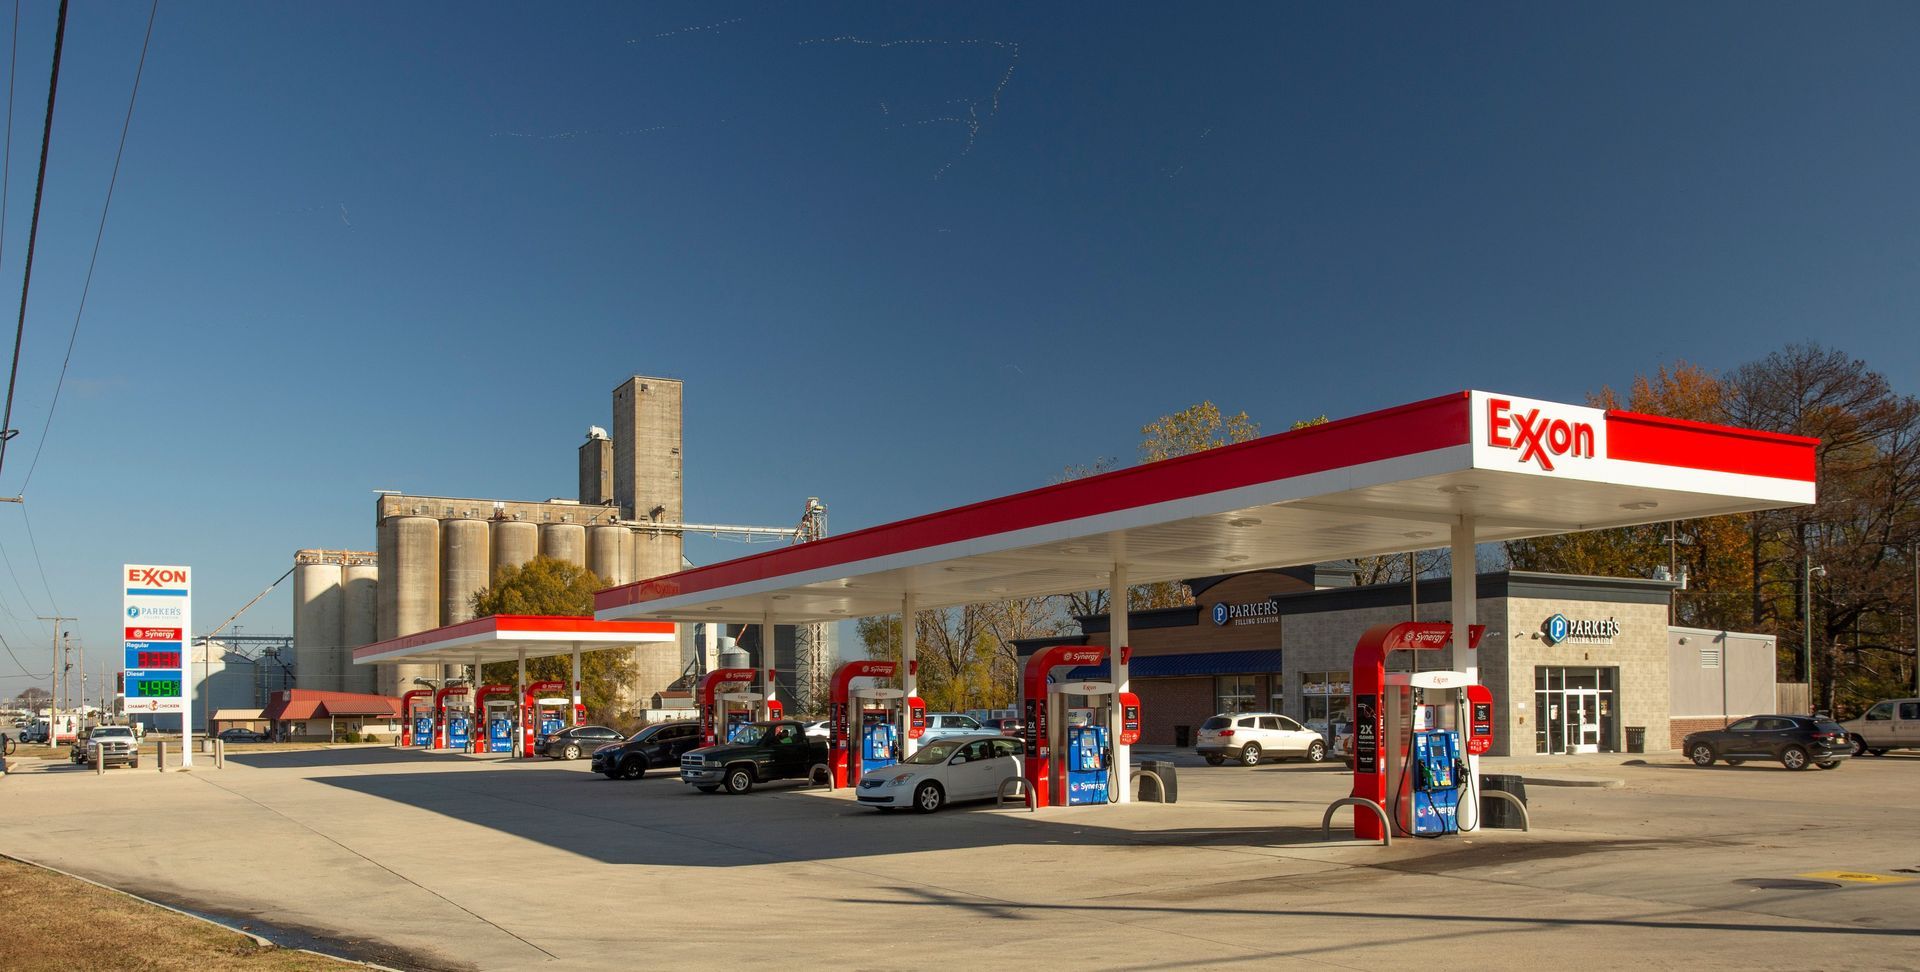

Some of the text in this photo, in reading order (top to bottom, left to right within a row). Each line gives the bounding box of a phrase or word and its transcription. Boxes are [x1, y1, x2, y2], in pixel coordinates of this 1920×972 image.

[1487, 398, 1594, 471] Exxon
[128, 568, 186, 587] EXXON
[142, 607, 181, 616] PARKER'S
[1230, 598, 1278, 618] PARKER'S
[1256, 616, 1279, 624] STATION
[1570, 617, 1620, 636] PARKER'S
[145, 630, 175, 639] Synergy
[1415, 632, 1445, 644] Synergy
[1073, 653, 1100, 661] Synergy
[870, 666, 893, 674] Synergy
[1360, 724, 1373, 734] 2X
